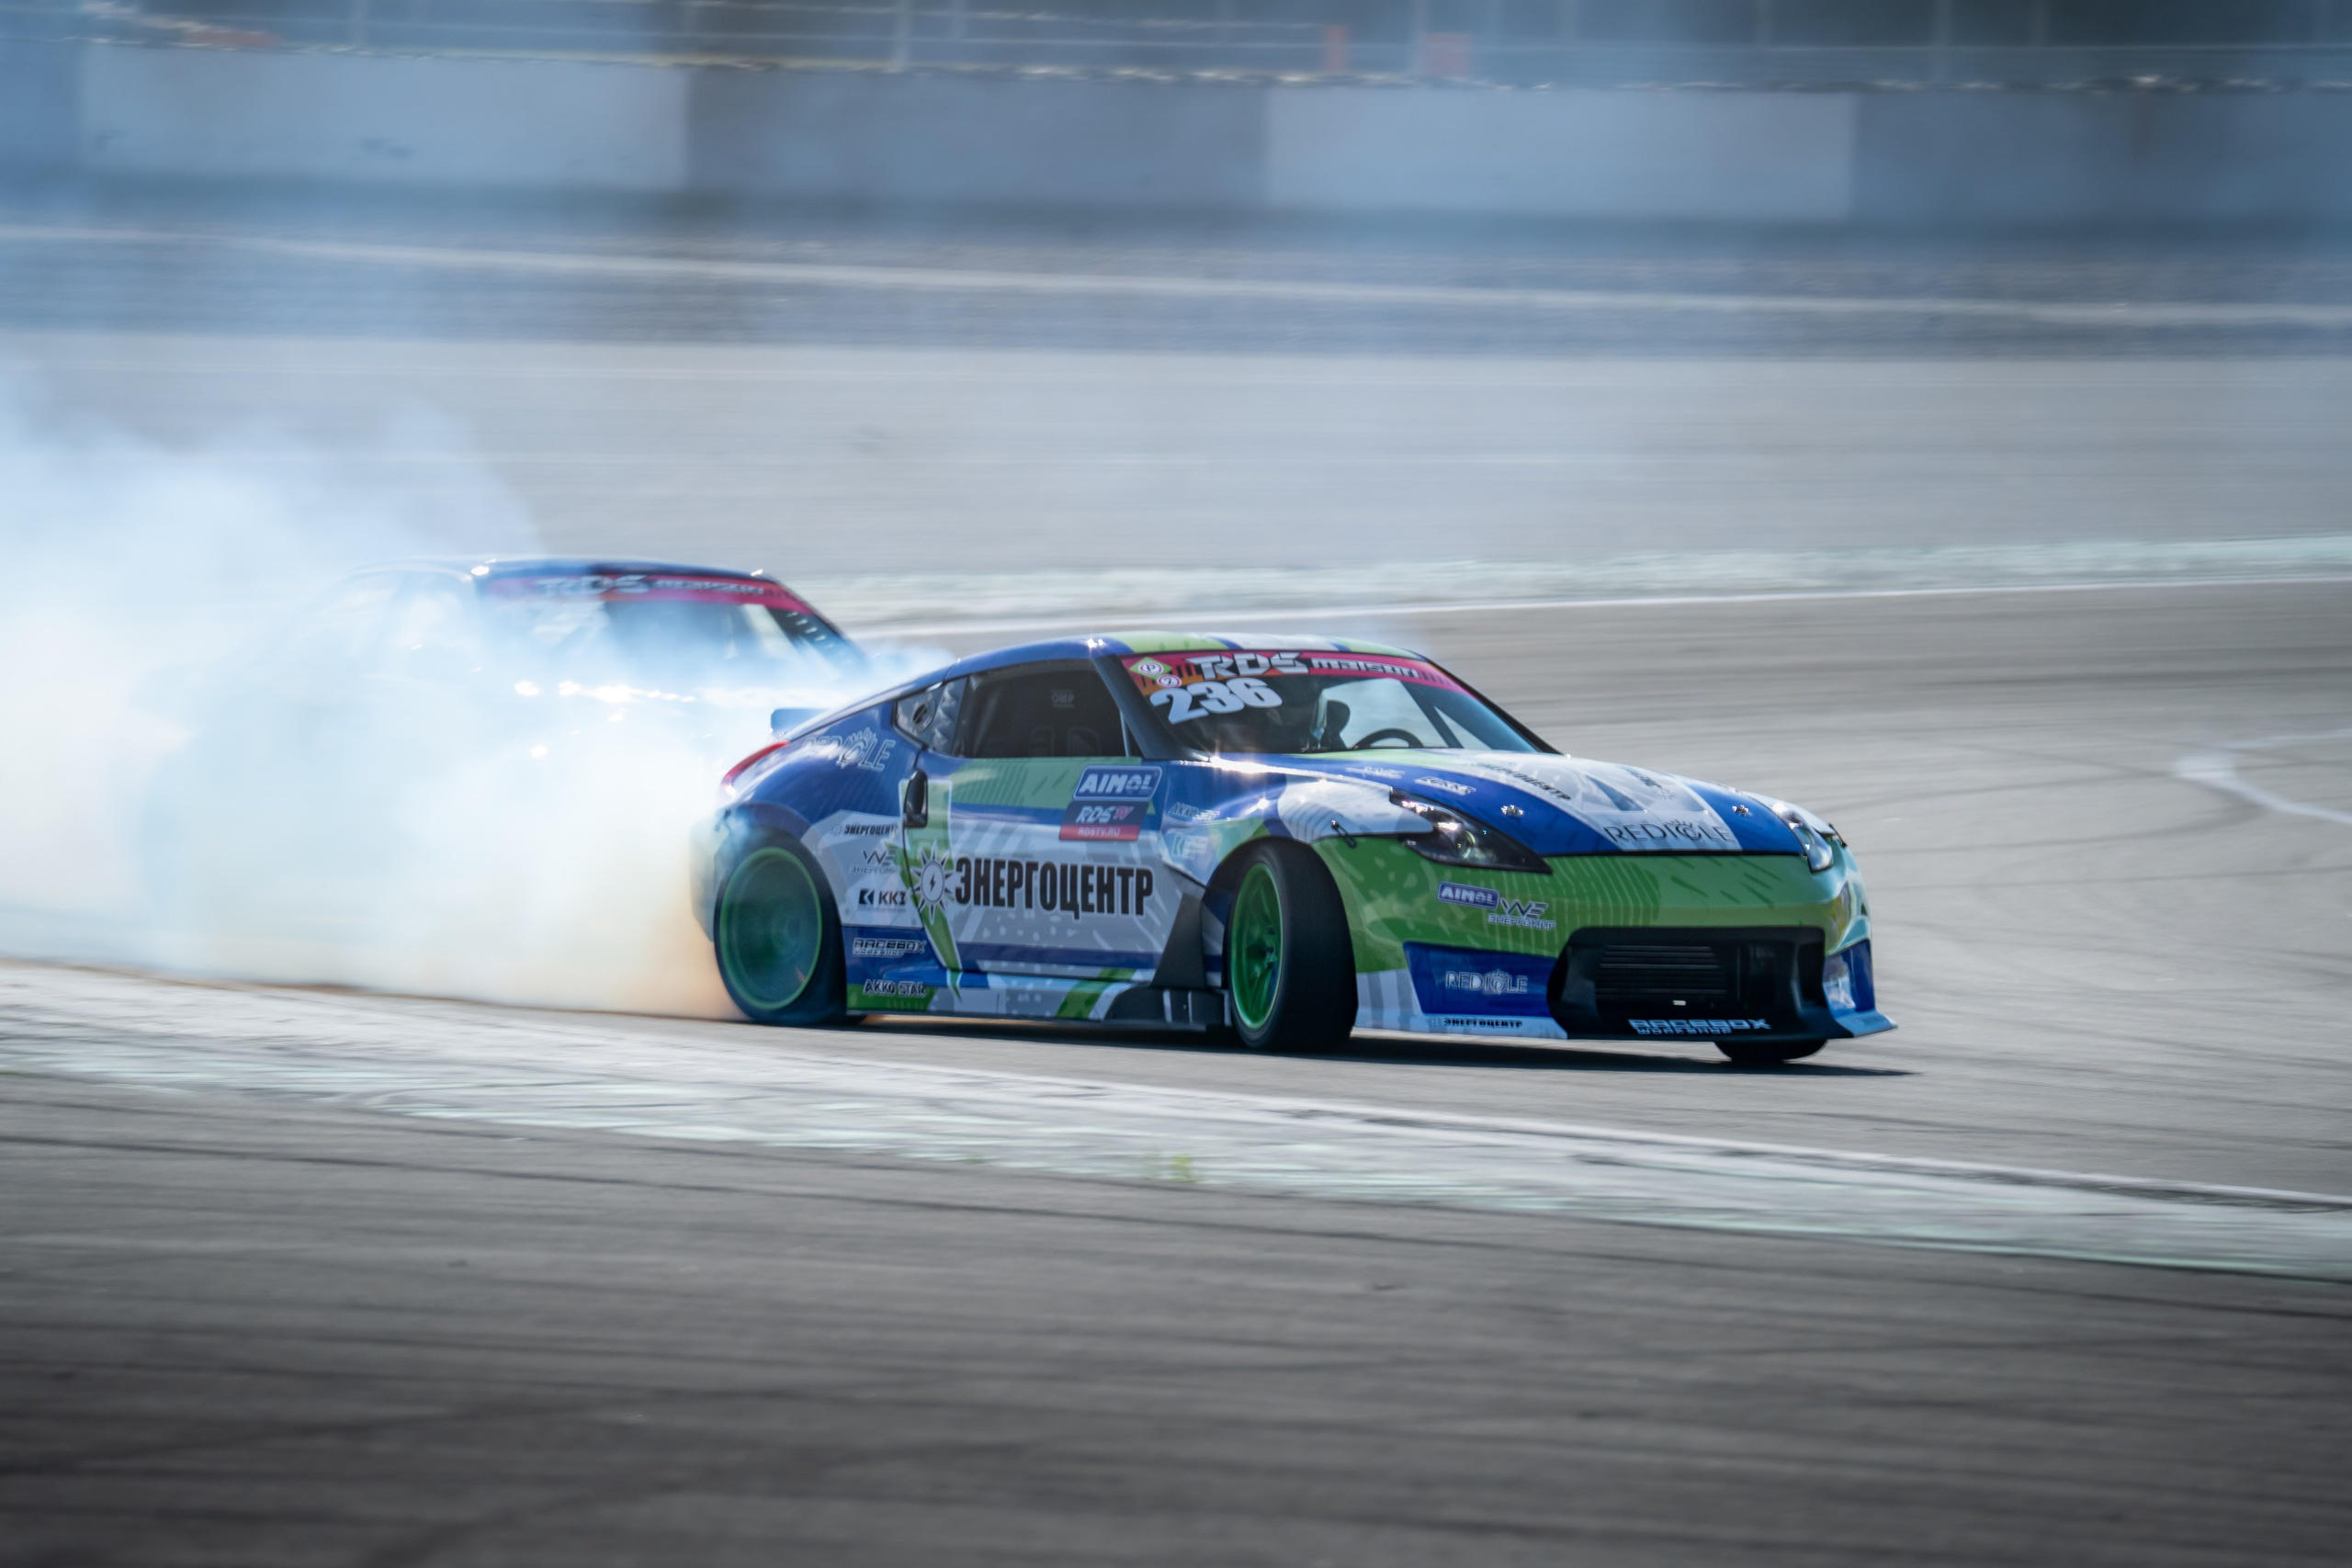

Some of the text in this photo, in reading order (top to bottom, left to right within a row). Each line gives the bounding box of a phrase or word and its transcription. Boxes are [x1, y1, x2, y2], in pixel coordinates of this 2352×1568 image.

[1184, 652, 1309, 681] RDS
[1149, 677, 1283, 725] 236
[1078, 773, 1152, 795] AIMOL
[955, 856, 1154, 920] ЭНЕРГОЦЕНТР
